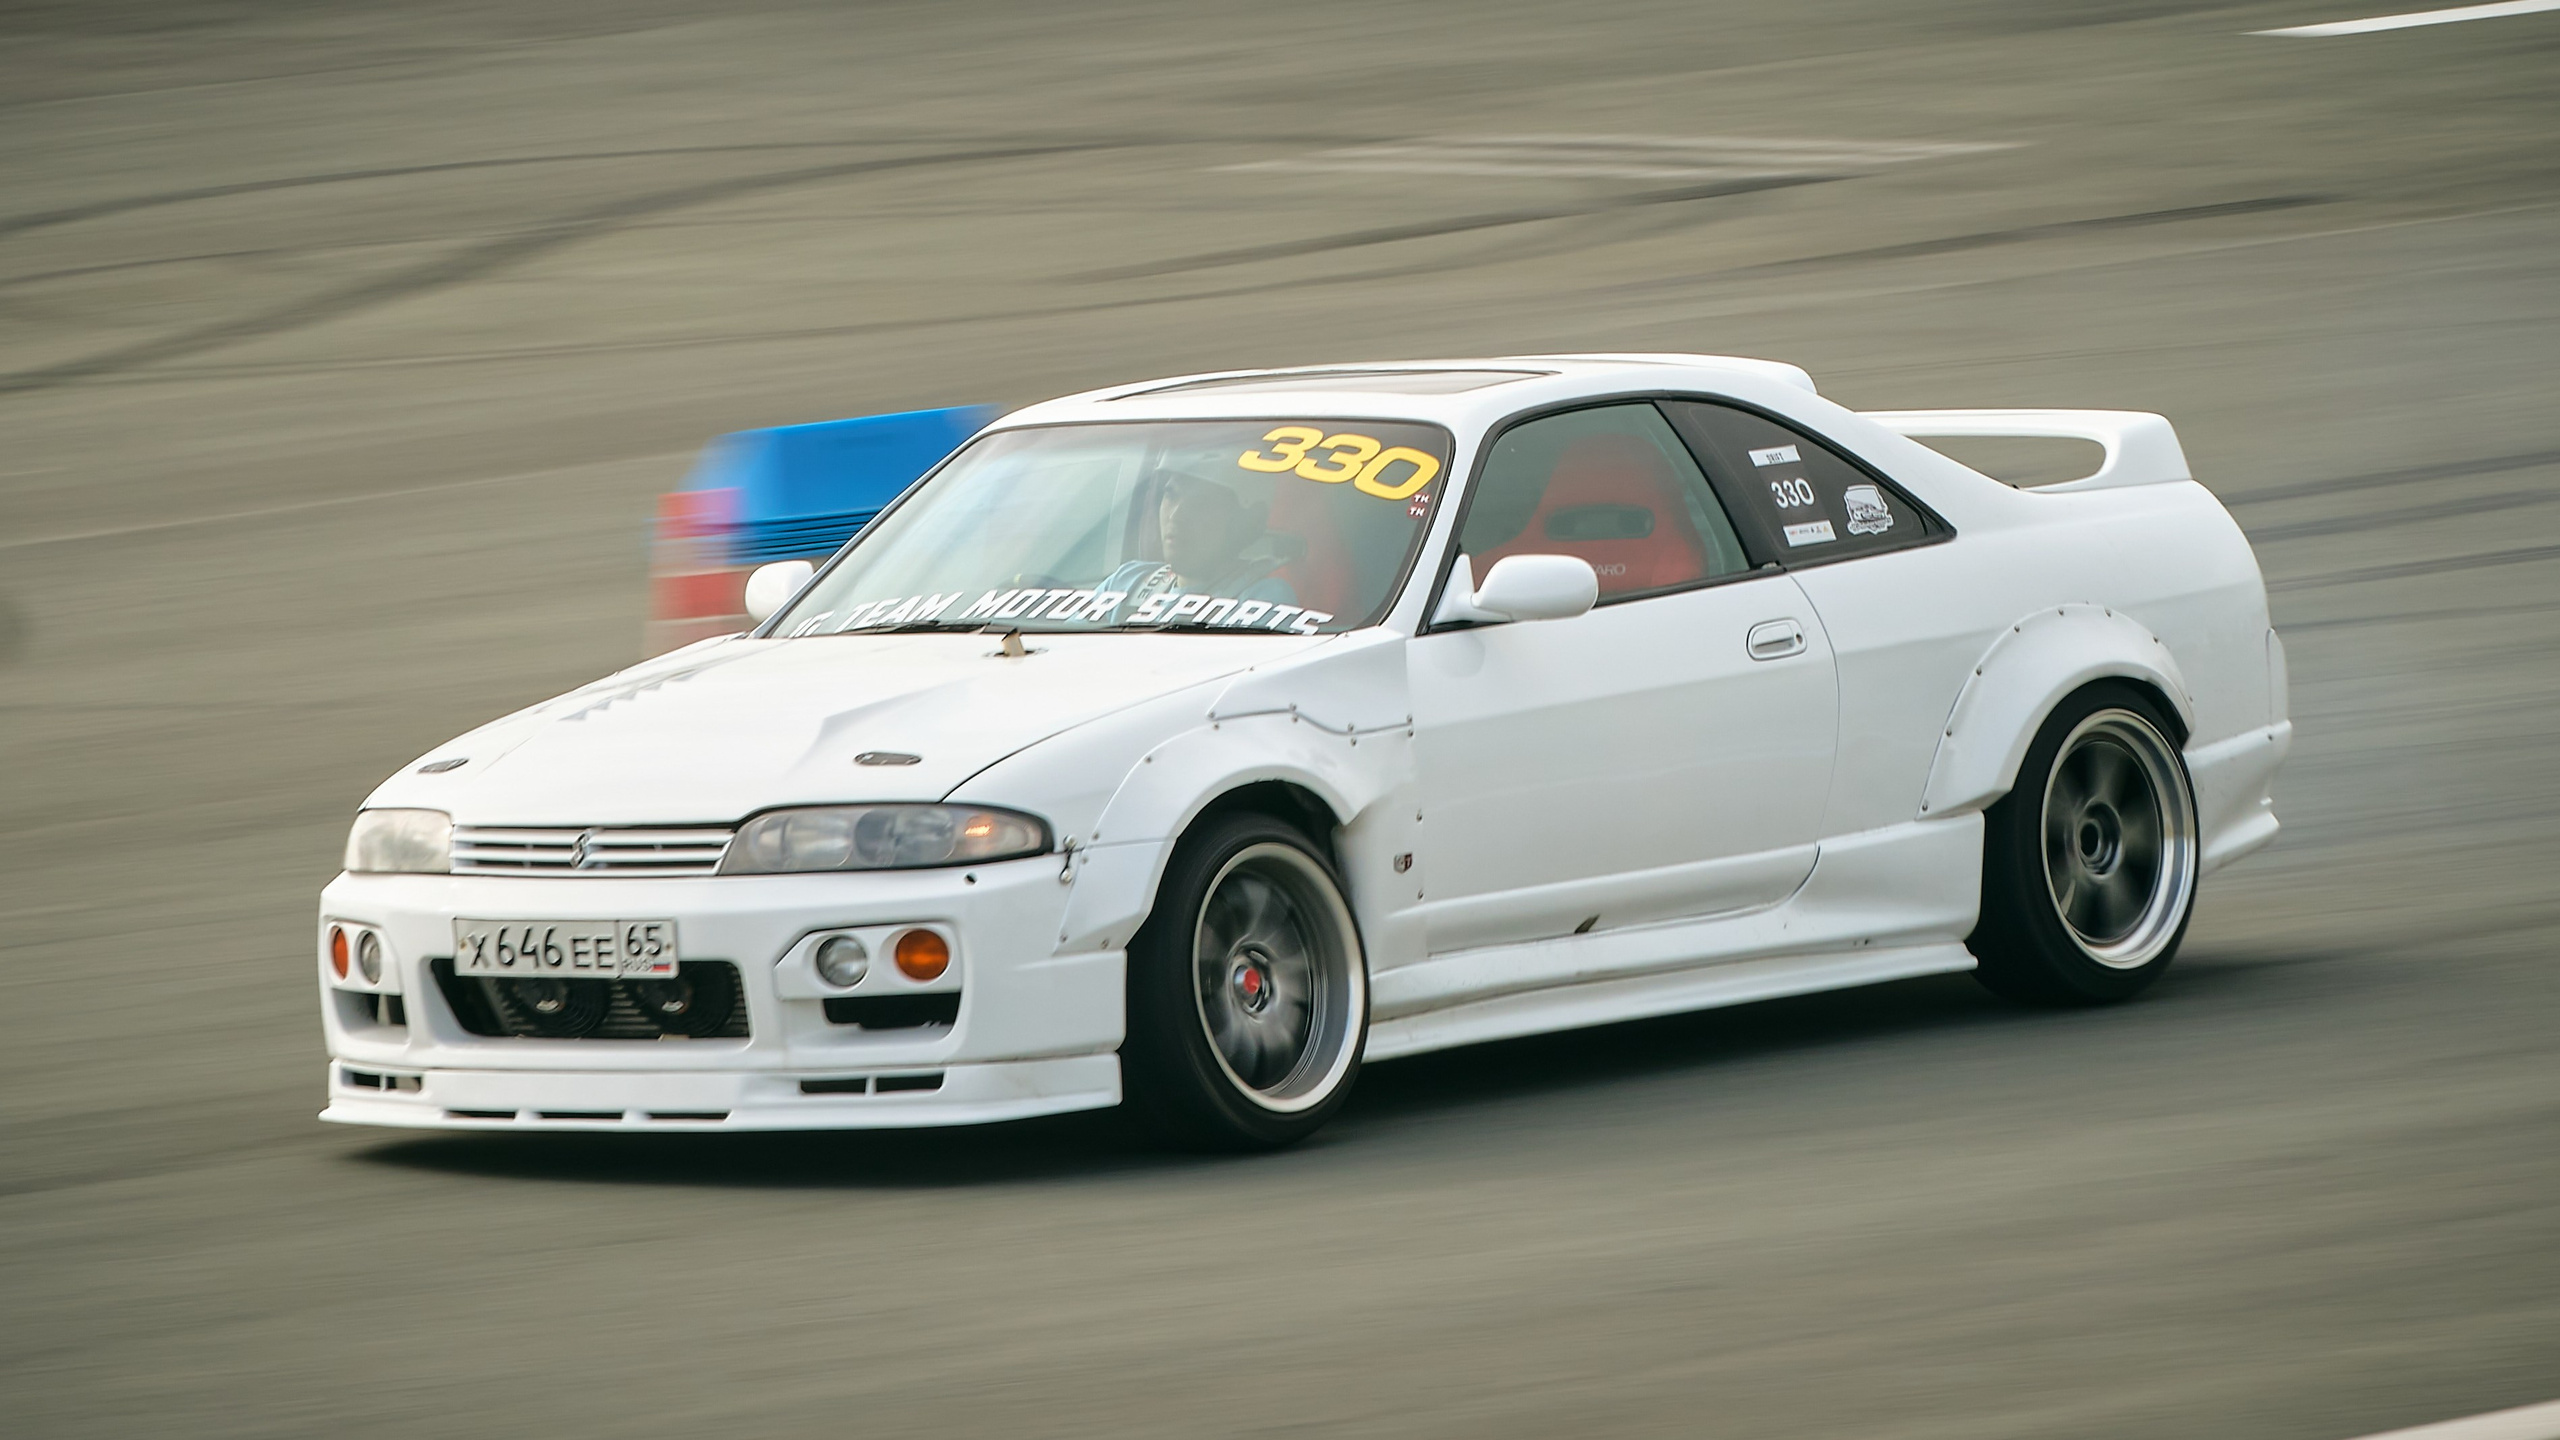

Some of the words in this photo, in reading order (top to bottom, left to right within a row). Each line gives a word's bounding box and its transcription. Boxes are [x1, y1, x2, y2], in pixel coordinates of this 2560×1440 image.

[1237, 426, 1440, 500] 330
[1771, 478, 1815, 509] 330
[834, 592, 964, 634] TEAM
[957, 588, 1128, 622] MOTOR
[1126, 592, 1335, 636] SPORTS
[625, 924, 662, 956] 65
